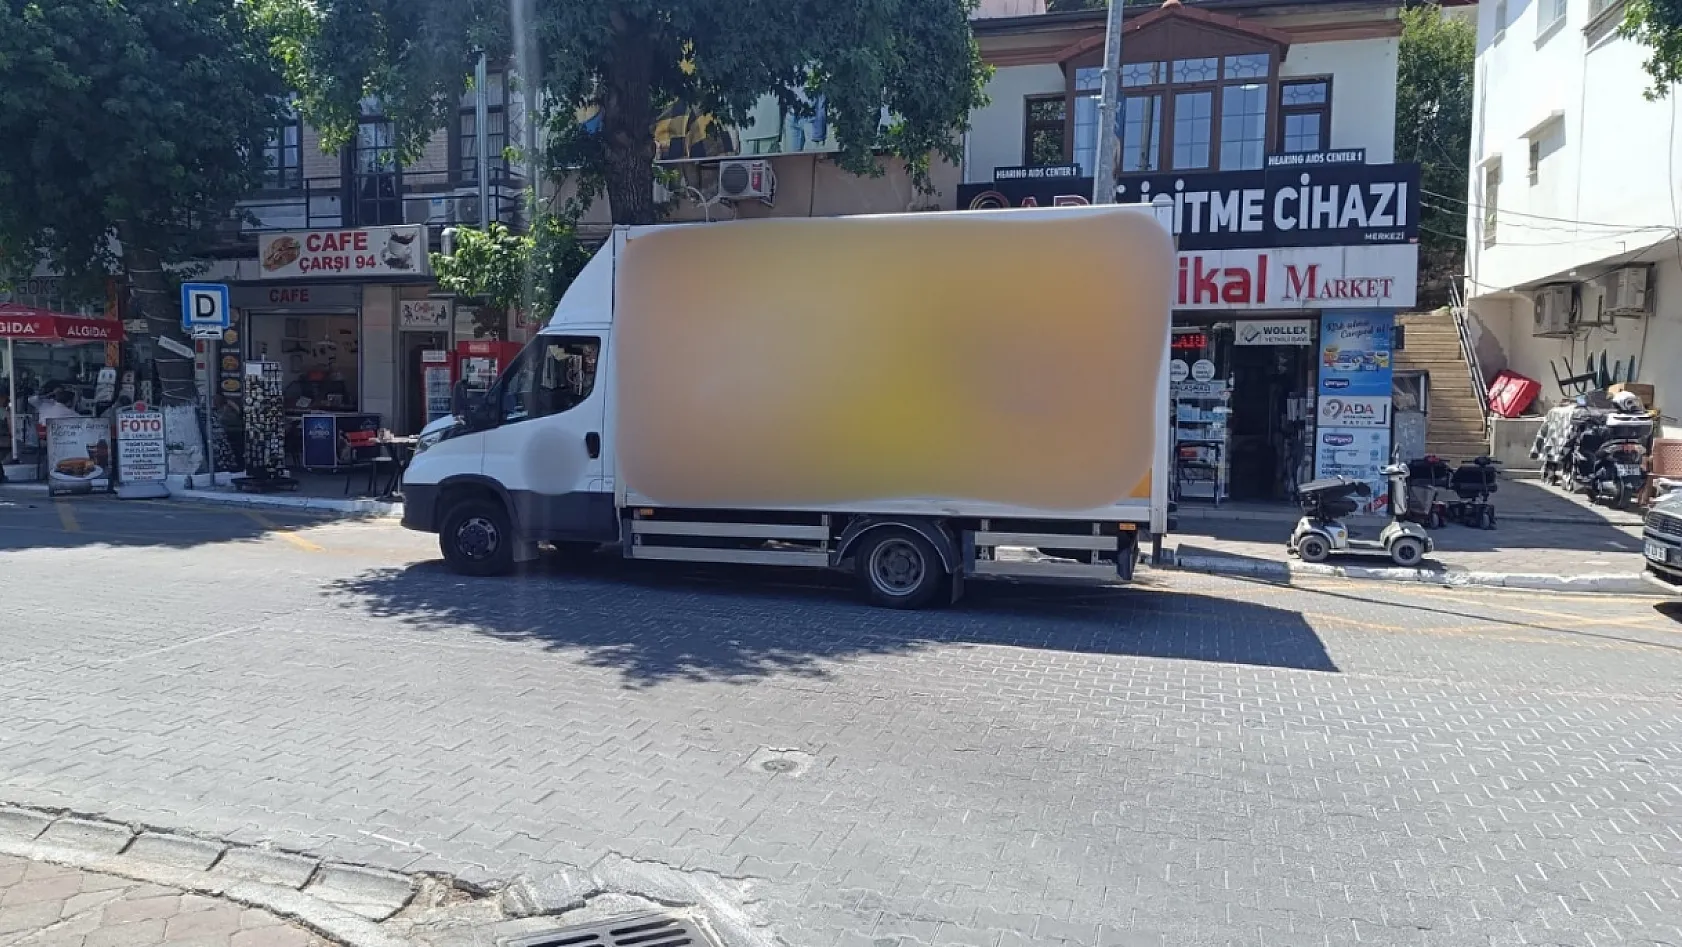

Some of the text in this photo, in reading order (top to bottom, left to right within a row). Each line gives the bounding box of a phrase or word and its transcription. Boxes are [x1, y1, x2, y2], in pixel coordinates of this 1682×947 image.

[1268, 152, 1356, 166] HEARING AIDS CENTER
[996, 167, 1071, 179] HEARING AIDS CENTER
[1141, 172, 1408, 234] İTME CİHAZI
[306, 231, 369, 252] CAFE
[299, 254, 377, 274] ÇARŞI 94
[269, 288, 309, 302] CAFE
[195, 293, 215, 317] D
[1263, 326, 1307, 335] WOLLEX
[1343, 403, 1374, 414] ADA
[121, 419, 161, 433] FOTO
